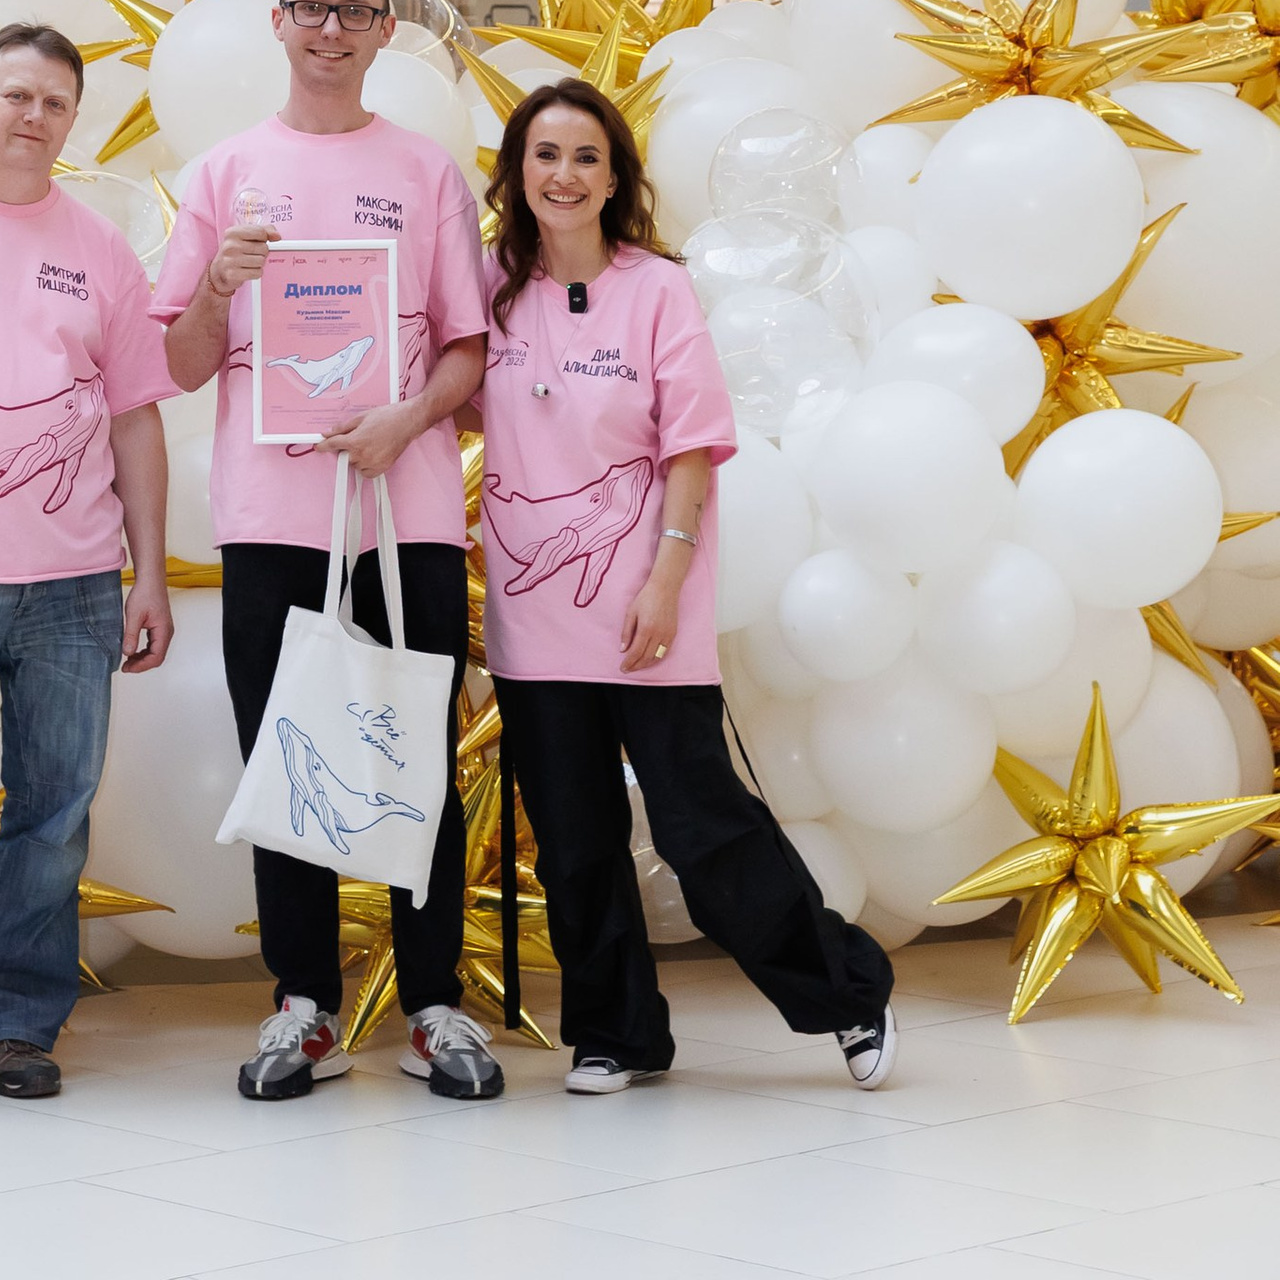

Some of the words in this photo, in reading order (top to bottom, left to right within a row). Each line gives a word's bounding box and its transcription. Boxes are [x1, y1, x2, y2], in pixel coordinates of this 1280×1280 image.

[269, 203, 293, 213] ЕСНА
[356, 194, 403, 215] МАКСИМ
[270, 211, 293, 224] 2025
[354, 211, 404, 233] КУЗЬМИН
[39, 262, 87, 285] ДМИТРИЙ
[36, 276, 89, 301] ТИЩЕНКО
[284, 283, 363, 299] Диплом
[505, 356, 526, 367] 2025
[590, 347, 621, 362] ДИНА
[562, 360, 638, 383] АЛИШПАНОВА
